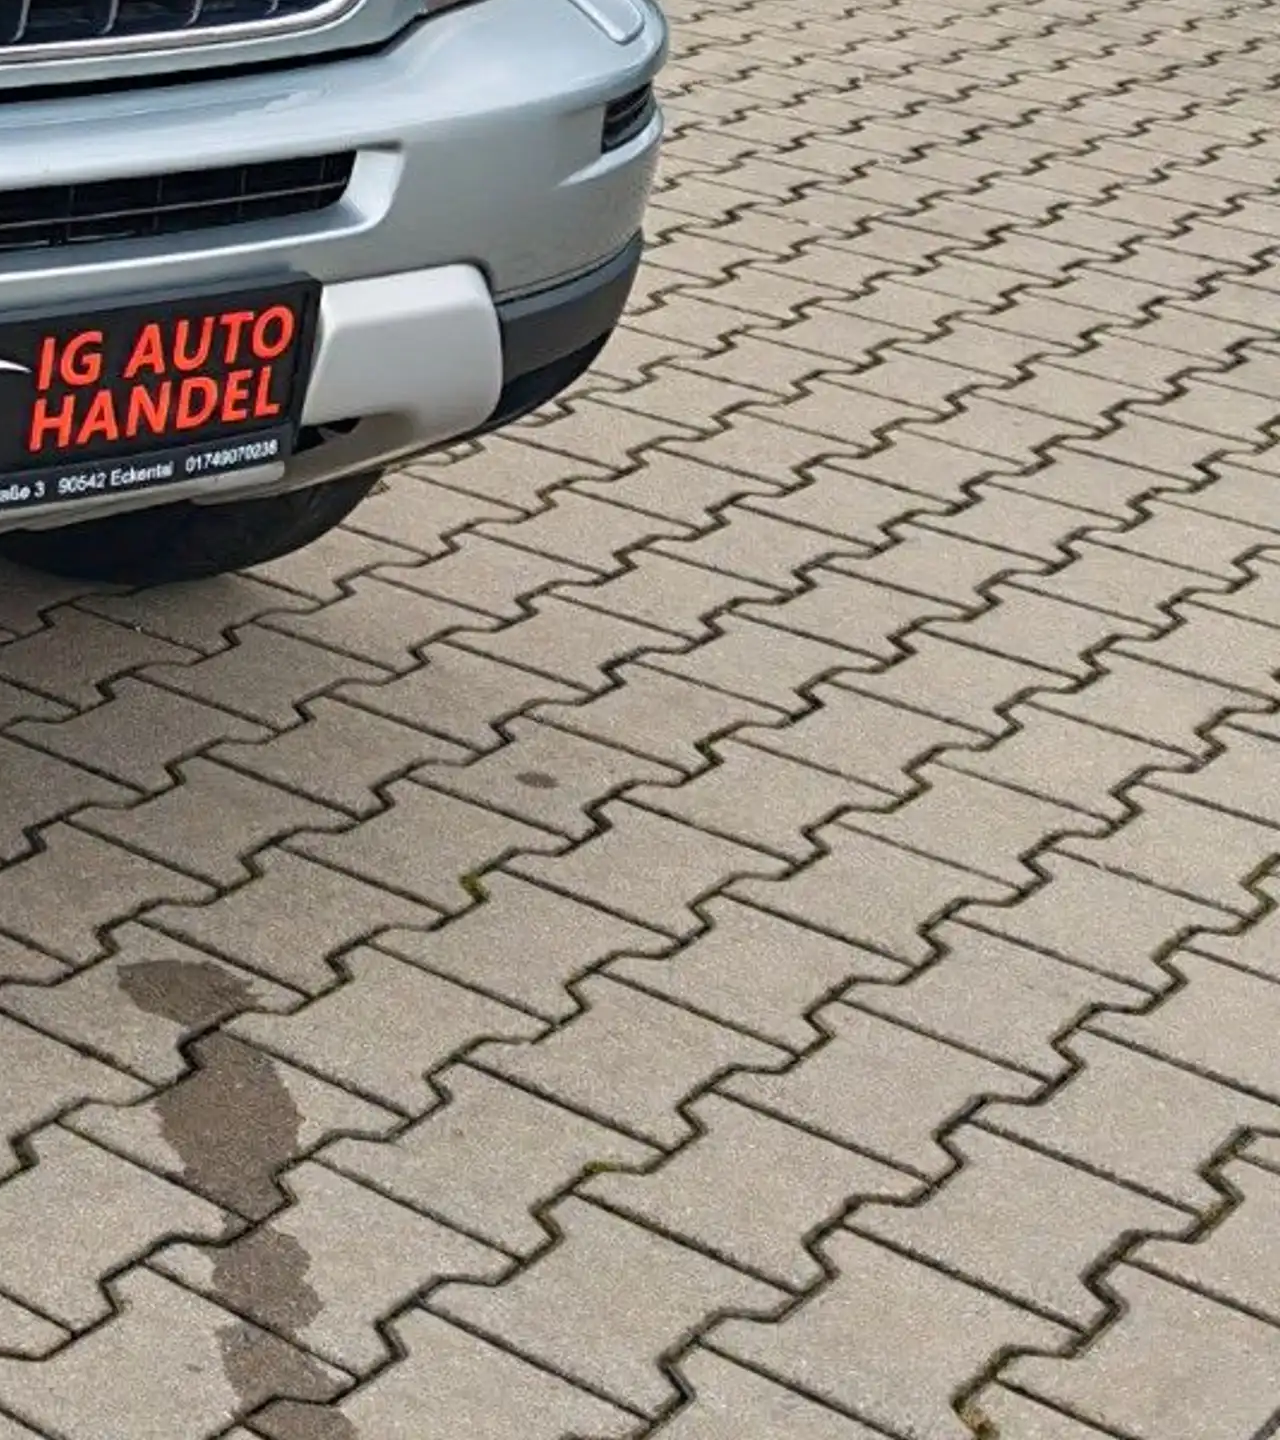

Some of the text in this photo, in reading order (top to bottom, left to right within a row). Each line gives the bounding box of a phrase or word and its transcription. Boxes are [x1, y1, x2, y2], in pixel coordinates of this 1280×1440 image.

[35, 305, 295, 391] IG AUTO
[28, 365, 281, 453] HANDEL
[34, 479, 46, 498] 3
[57, 472, 106, 494] 90542
[110, 460, 175, 487] Eckental
